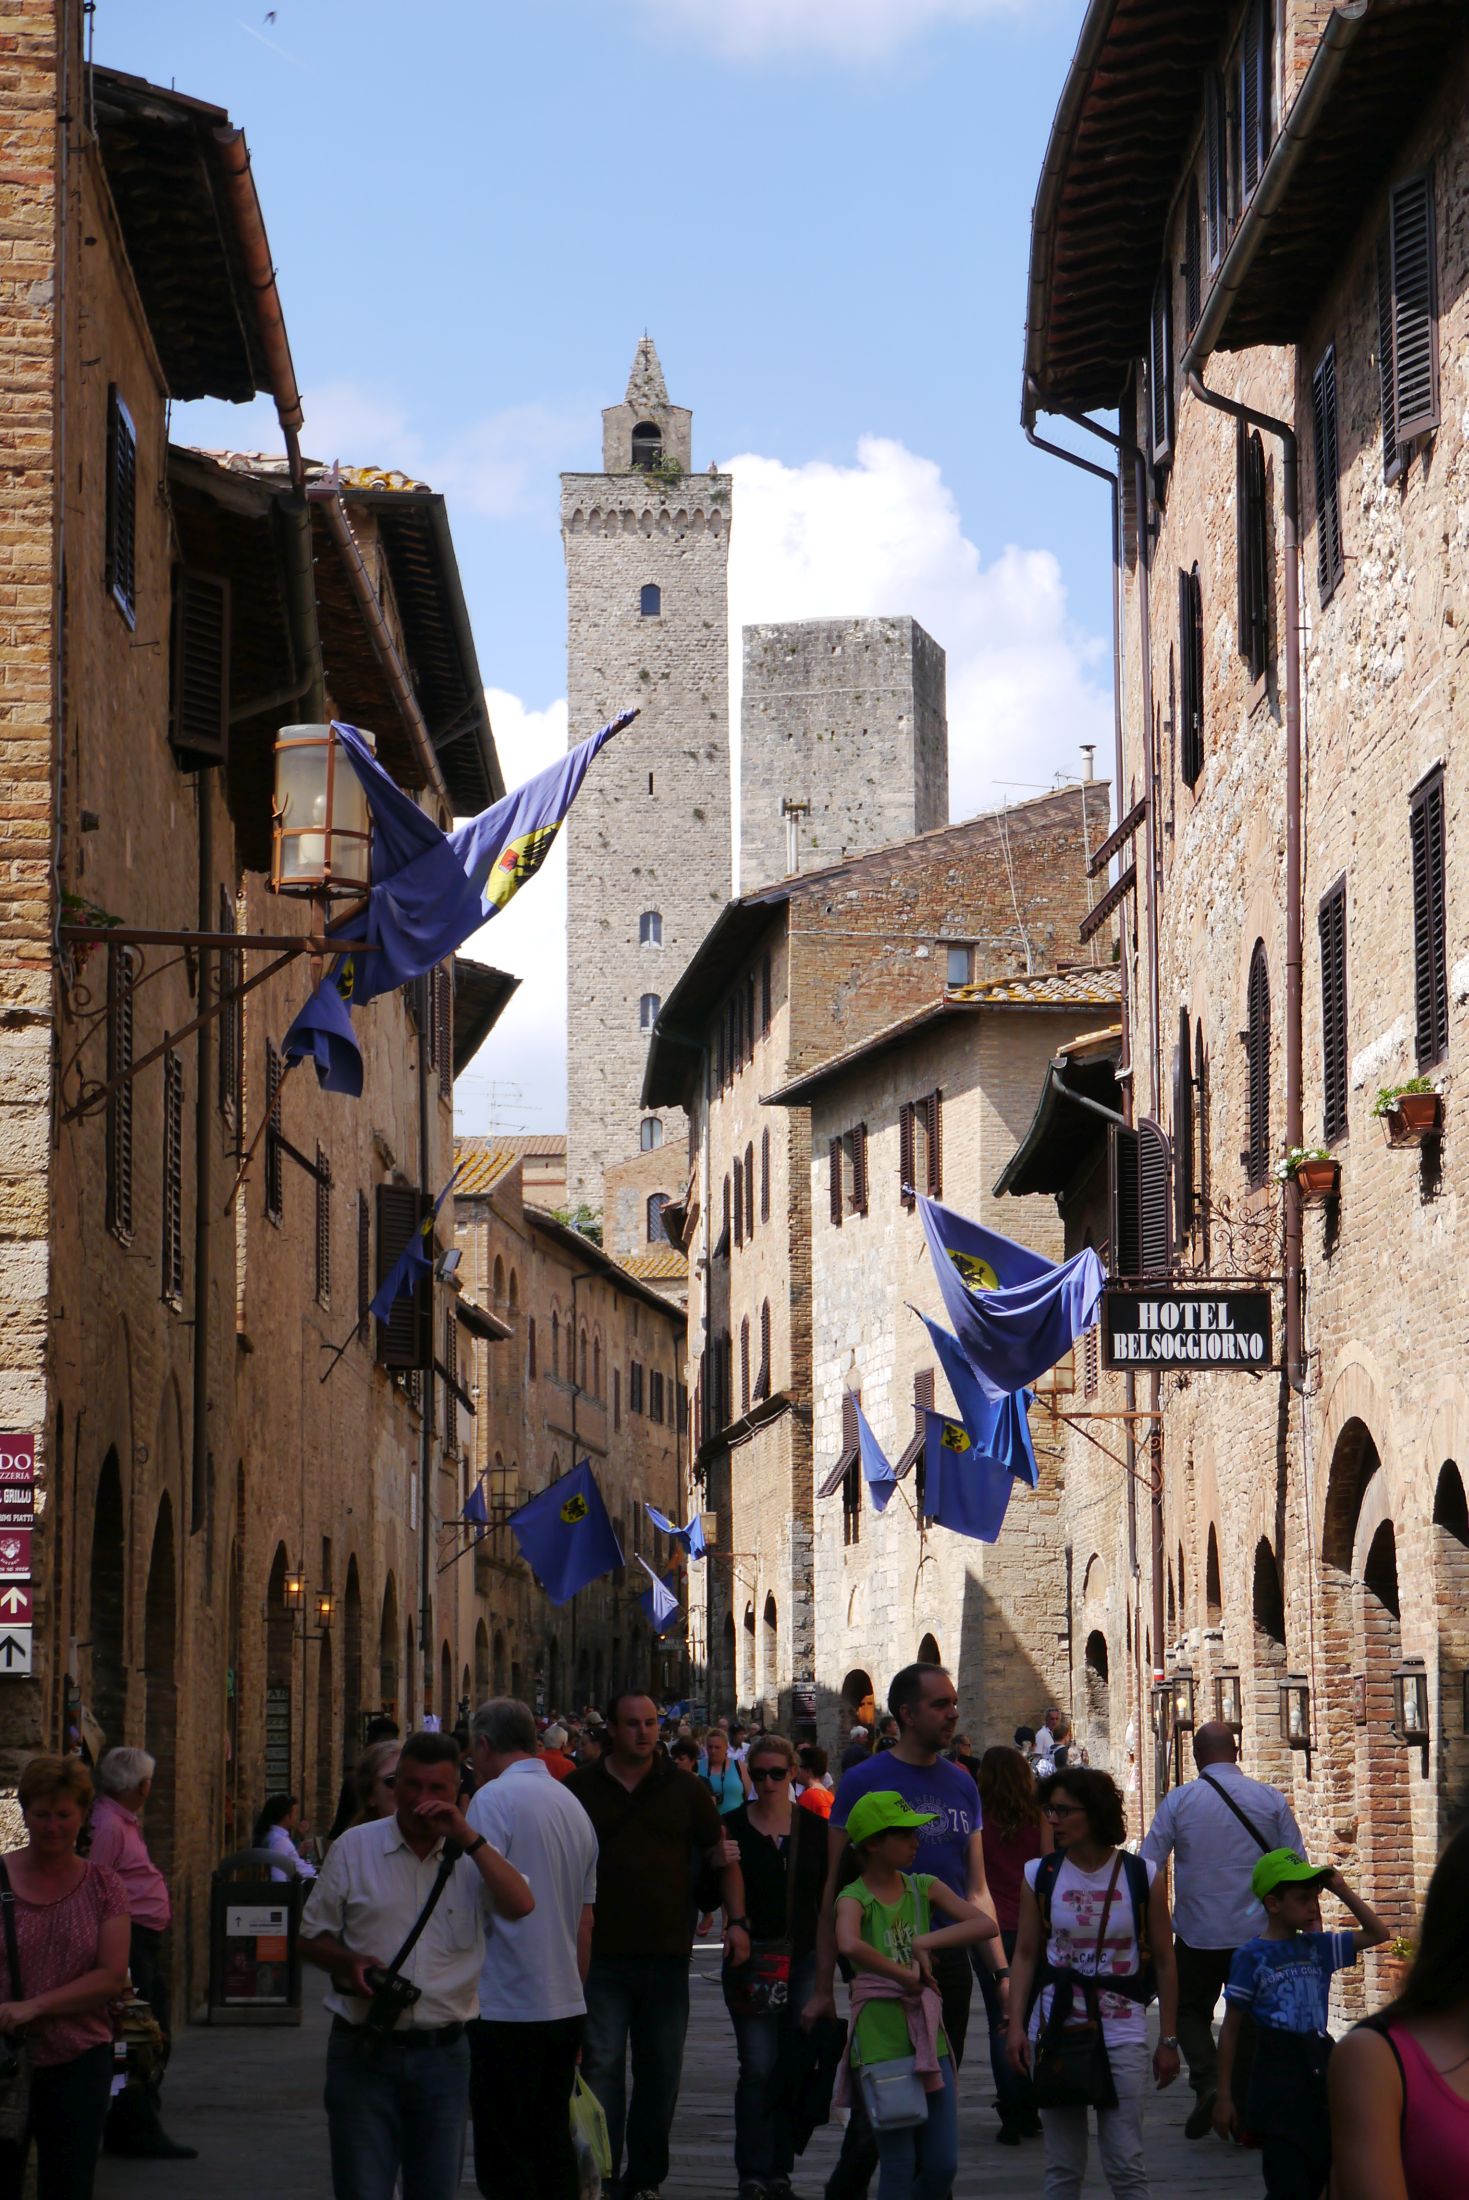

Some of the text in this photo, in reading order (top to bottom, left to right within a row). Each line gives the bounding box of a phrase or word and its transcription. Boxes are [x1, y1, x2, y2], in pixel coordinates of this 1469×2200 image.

[1138, 1302, 1234, 1330] HOTEL
[1113, 1333, 1263, 1360] BELSOGGIORNO
[3, 1489, 31, 1504] GRILLO
[13, 1514, 33, 1522] PIATTI
[948, 1808, 969, 1834] 76
[1079, 1953, 1107, 1964] CHC
